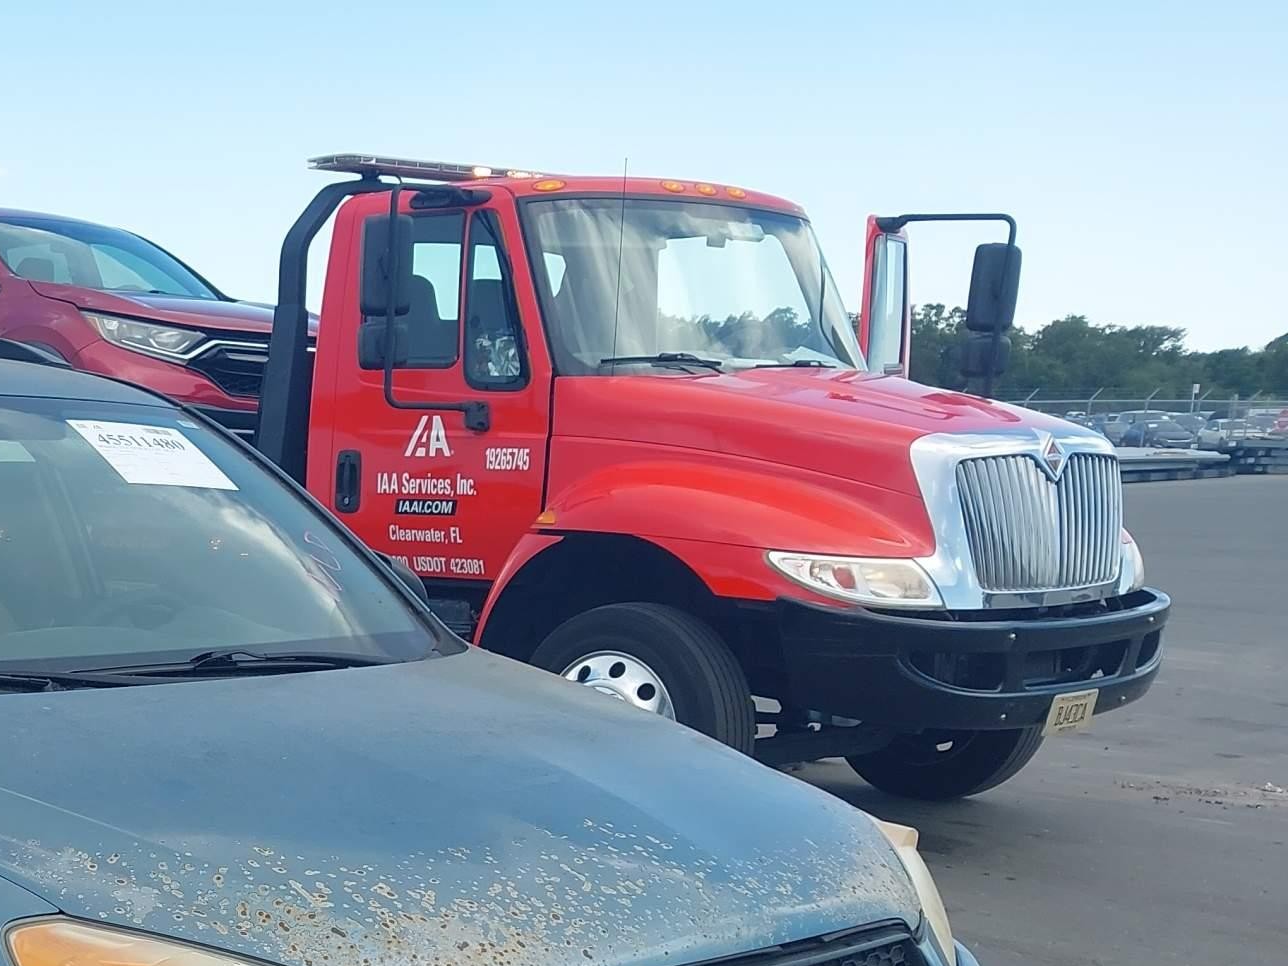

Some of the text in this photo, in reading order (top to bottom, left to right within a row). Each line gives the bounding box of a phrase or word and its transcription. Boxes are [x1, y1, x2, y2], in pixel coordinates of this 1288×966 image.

[97, 433, 186, 451] 45511480
[485, 447, 530, 471] 19265745
[377, 473, 477, 497] IAA Services, Inc.
[398, 500, 453, 514] IAAI.COM
[389, 524, 463, 544] Clearwater, FL
[413, 556, 446, 573] USDOT
[450, 558, 485, 575] 423081
